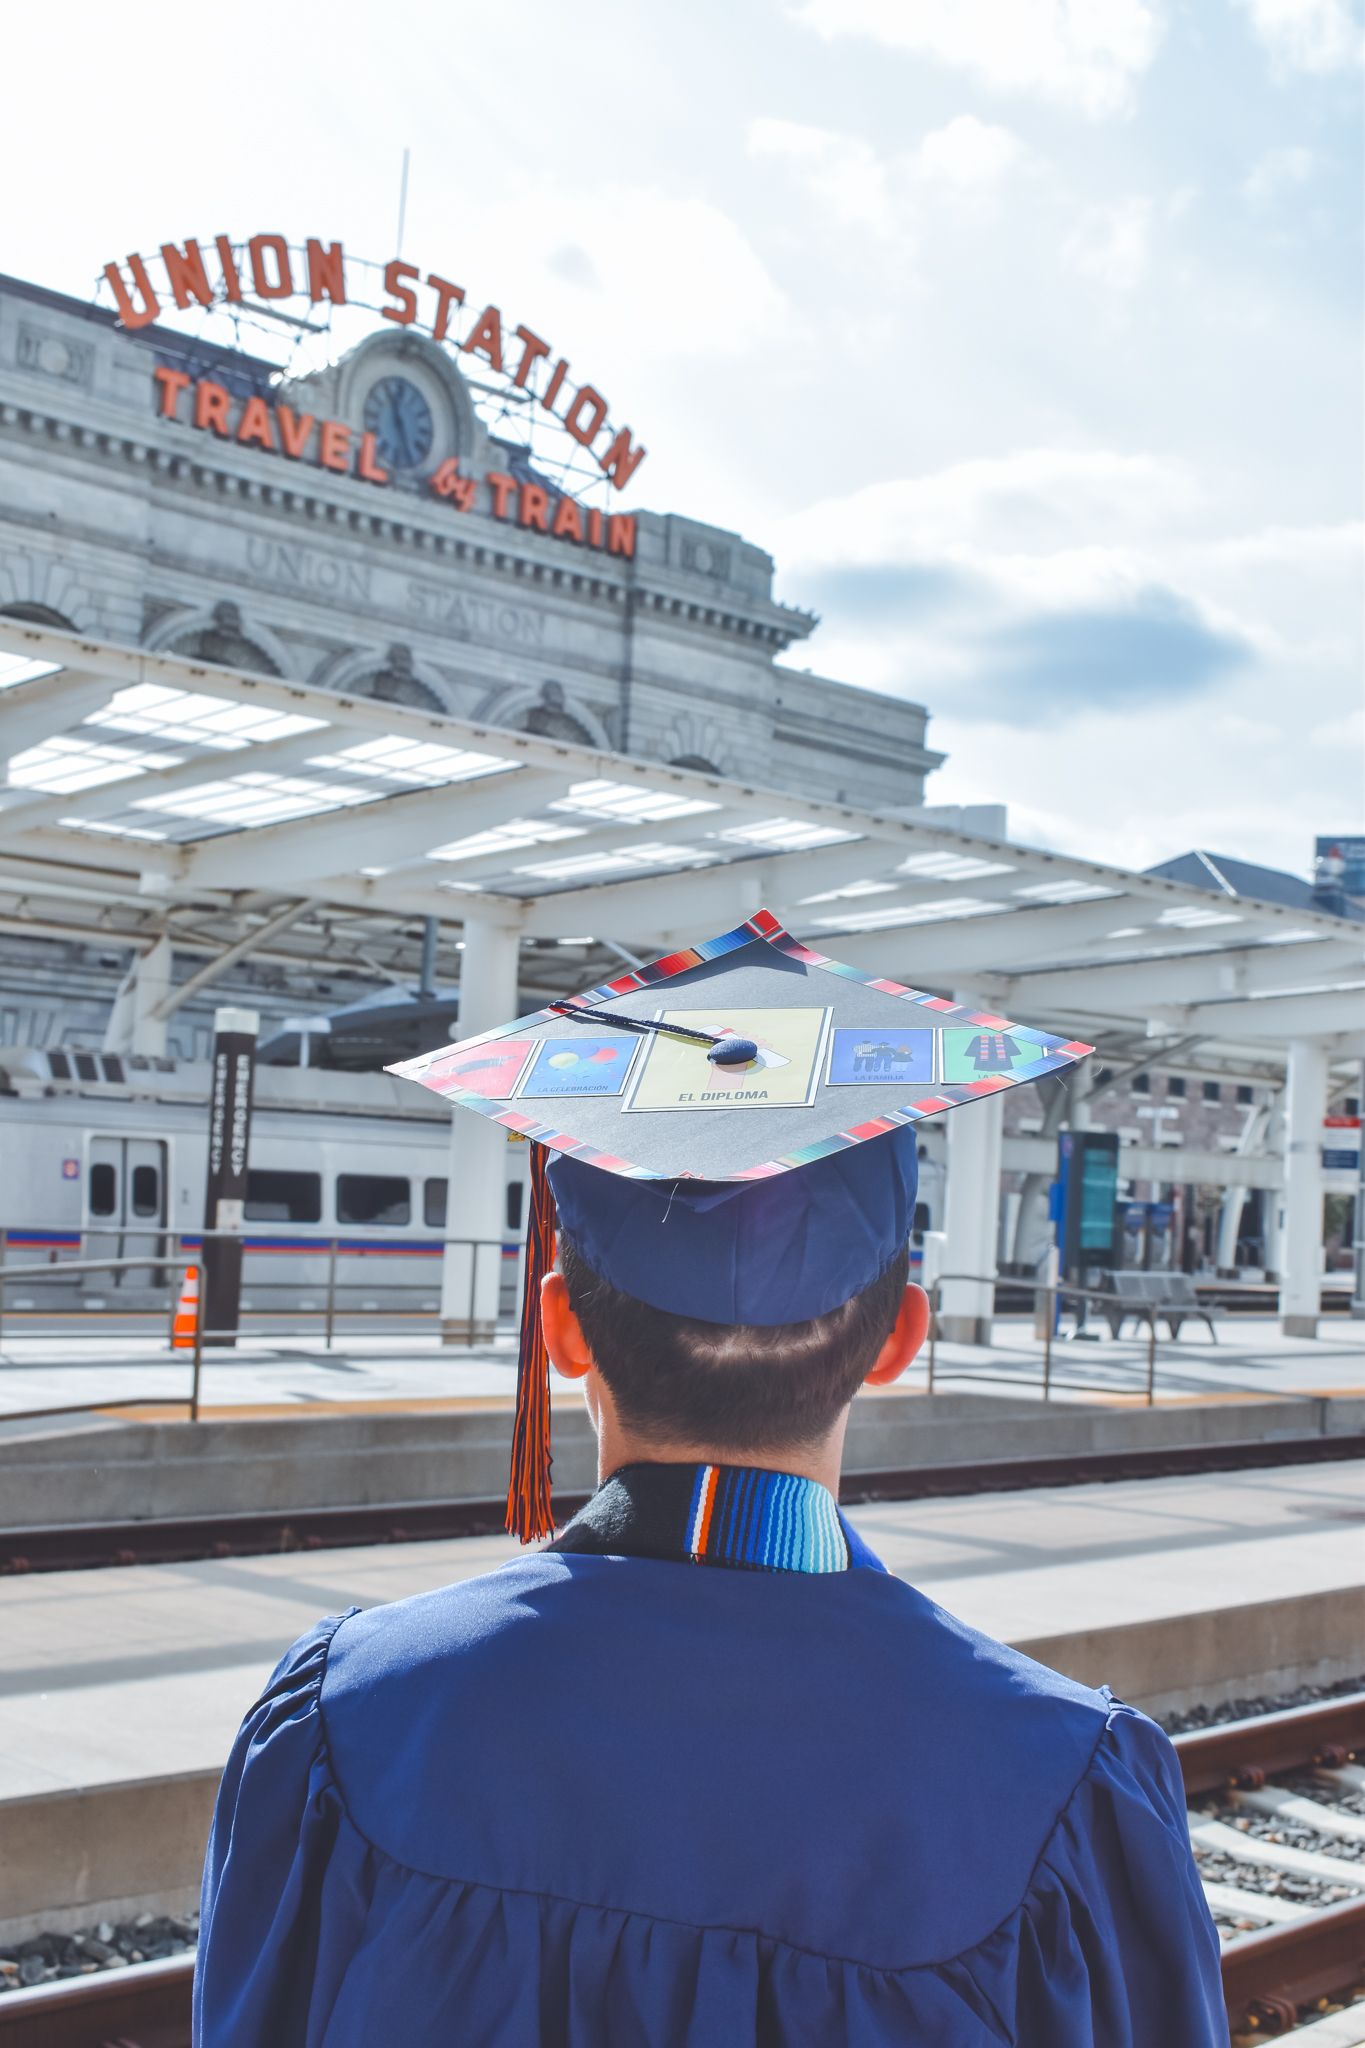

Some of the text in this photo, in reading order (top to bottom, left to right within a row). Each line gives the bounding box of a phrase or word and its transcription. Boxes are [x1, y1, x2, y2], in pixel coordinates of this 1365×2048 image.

[104, 234, 646, 491] UNION STATION
[154, 366, 637, 558] TRAVEL by TRAIN
[245, 537, 546, 643] UNION STATION
[211, 1053, 228, 1176] EMERGENCY
[231, 1053, 250, 1177] EMERGENCY
[678, 1090, 769, 1102] EL DIPLOMA
